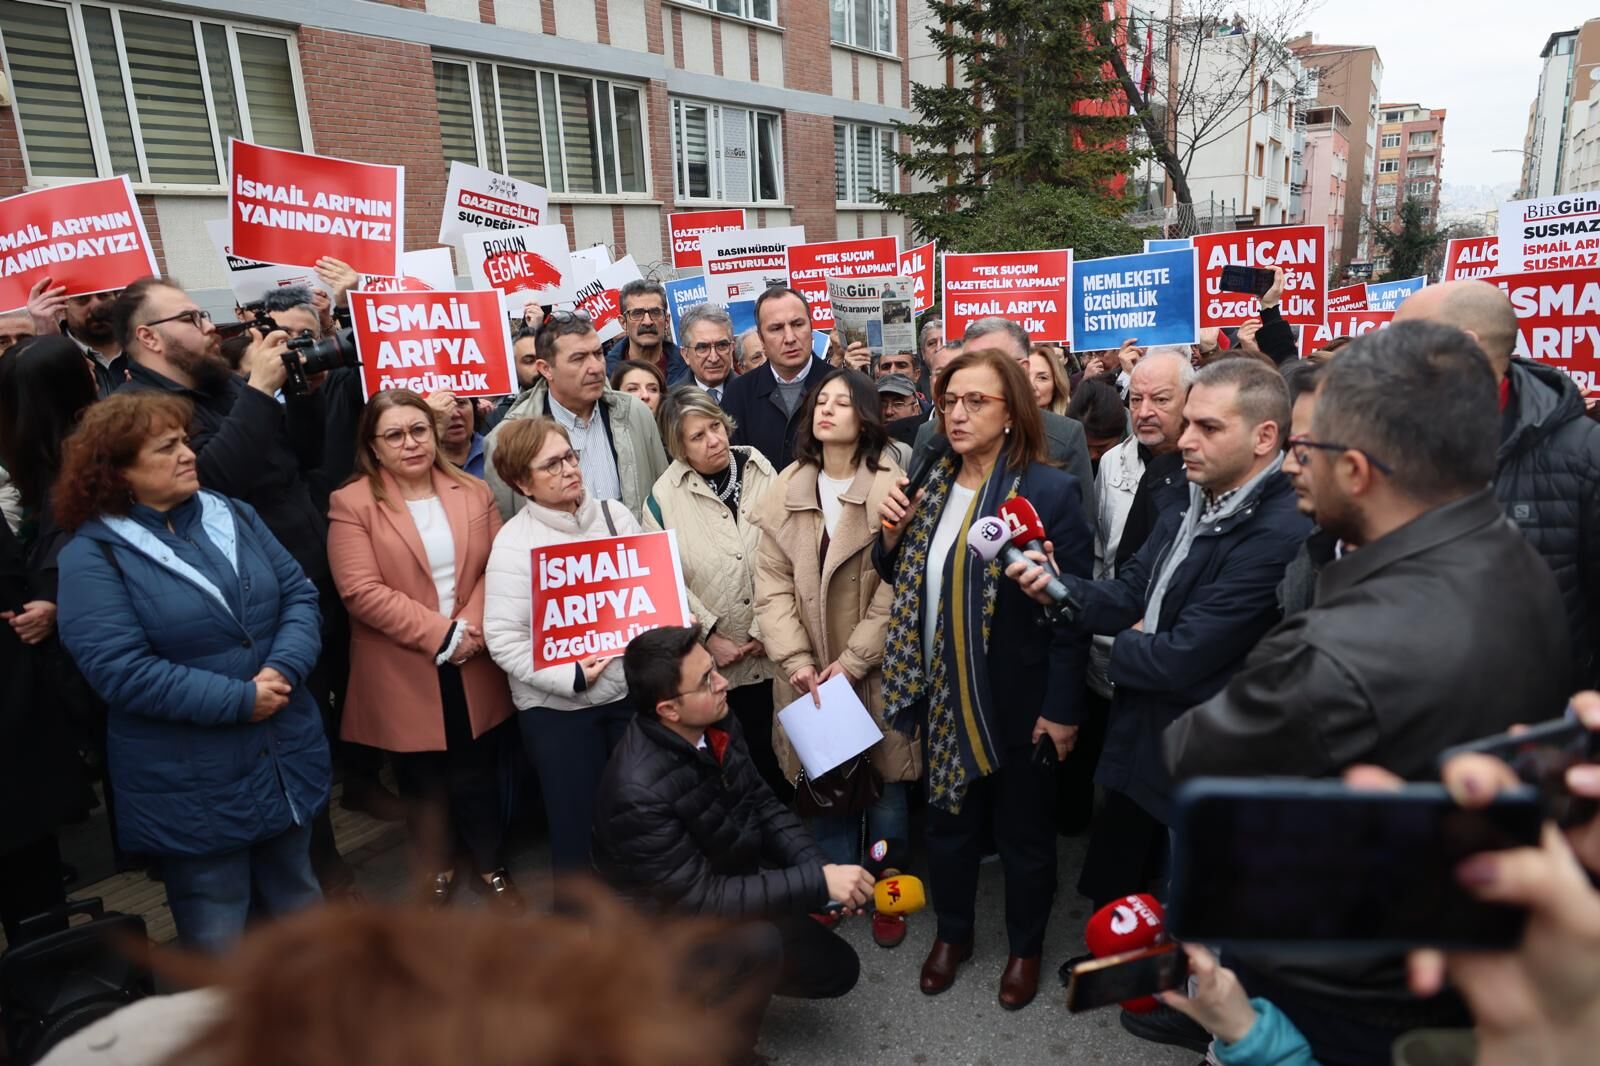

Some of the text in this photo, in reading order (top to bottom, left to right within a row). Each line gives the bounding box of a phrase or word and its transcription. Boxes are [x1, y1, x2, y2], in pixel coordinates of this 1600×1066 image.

[237, 174, 392, 217] İSMAİL ARI'NIN
[458, 211, 483, 228] SUÇ
[461, 194, 538, 223] GAZETECİLİK
[0, 210, 132, 252] MAİL ARI'NIN
[237, 201, 391, 241] YANINDAYIZ!
[1524, 219, 1600, 239] SUSMAZ
[483, 235, 527, 259] BOYUN
[718, 246, 747, 257] BASIN
[841, 250, 875, 263] SUÇUM
[1206, 237, 1316, 270] ALİCAN
[1523, 240, 1571, 256] İSMAİL
[488, 253, 534, 285] EĞME
[710, 257, 786, 271] SUSTURULAM
[791, 267, 853, 280] GAZETECİLİK
[1000, 264, 1038, 276] SUÇUM
[1523, 253, 1598, 272] SUSMAZ
[947, 278, 1013, 290] GAZETECİLİK
[1083, 268, 1169, 292] MEMLEKETE
[673, 284, 708, 303] İSMAİL
[1084, 290, 1158, 312] ÖZGÜRLÜK
[366, 298, 481, 332] İSMAİL
[954, 300, 1057, 316] İSMAİL ARI'YA
[1207, 295, 1316, 319] ÖZGÜLÜK
[1084, 309, 1156, 332] İSTİYORUZ
[377, 338, 485, 369] ARI'YA
[539, 543, 650, 591] İSMAİL
[542, 586, 656, 631] ARI'YA
